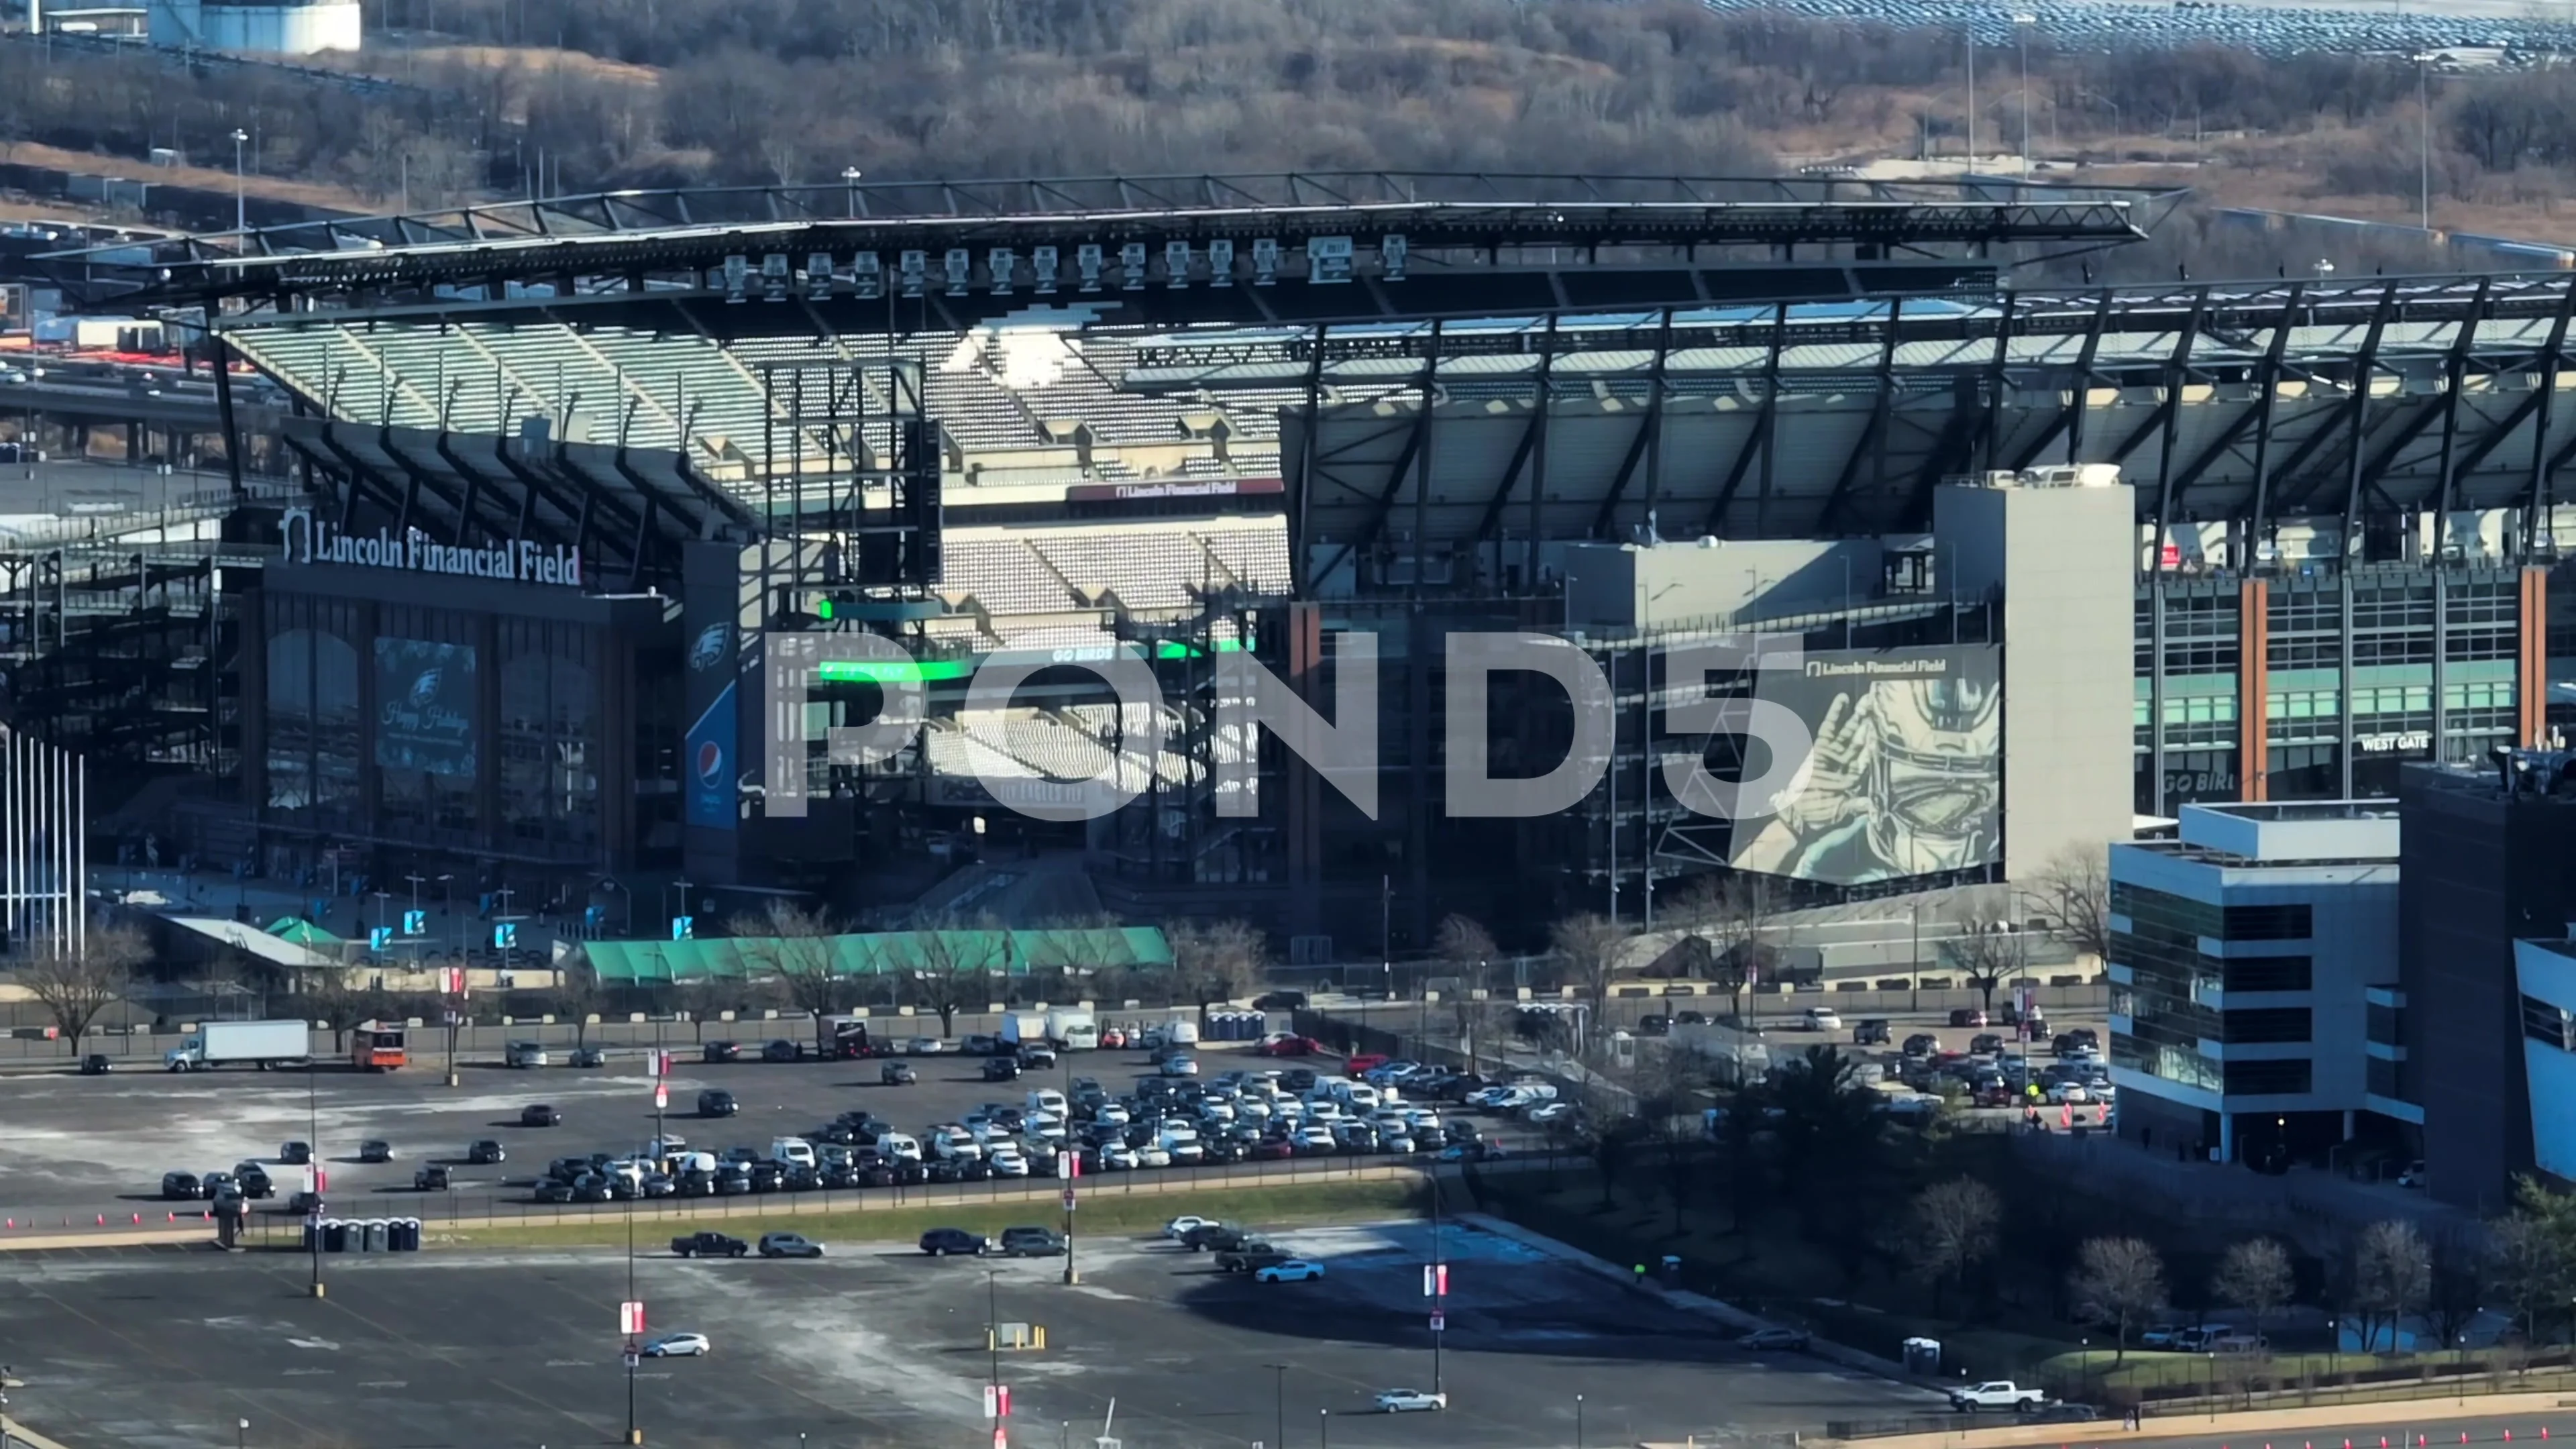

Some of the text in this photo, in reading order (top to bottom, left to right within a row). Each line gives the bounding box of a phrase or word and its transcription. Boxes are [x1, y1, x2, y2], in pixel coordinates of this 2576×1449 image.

[1128, 484, 1165, 498] Lincoln
[1212, 481, 1236, 494] Field
[316, 520, 581, 586] Lincoln Financial Field
[1052, 647, 1114, 663] GO BIRDS
[1822, 658, 1946, 676] Lincoln Financial Field
[2361, 735, 2429, 751] WEST GATE
[2164, 773, 2192, 794] GO
